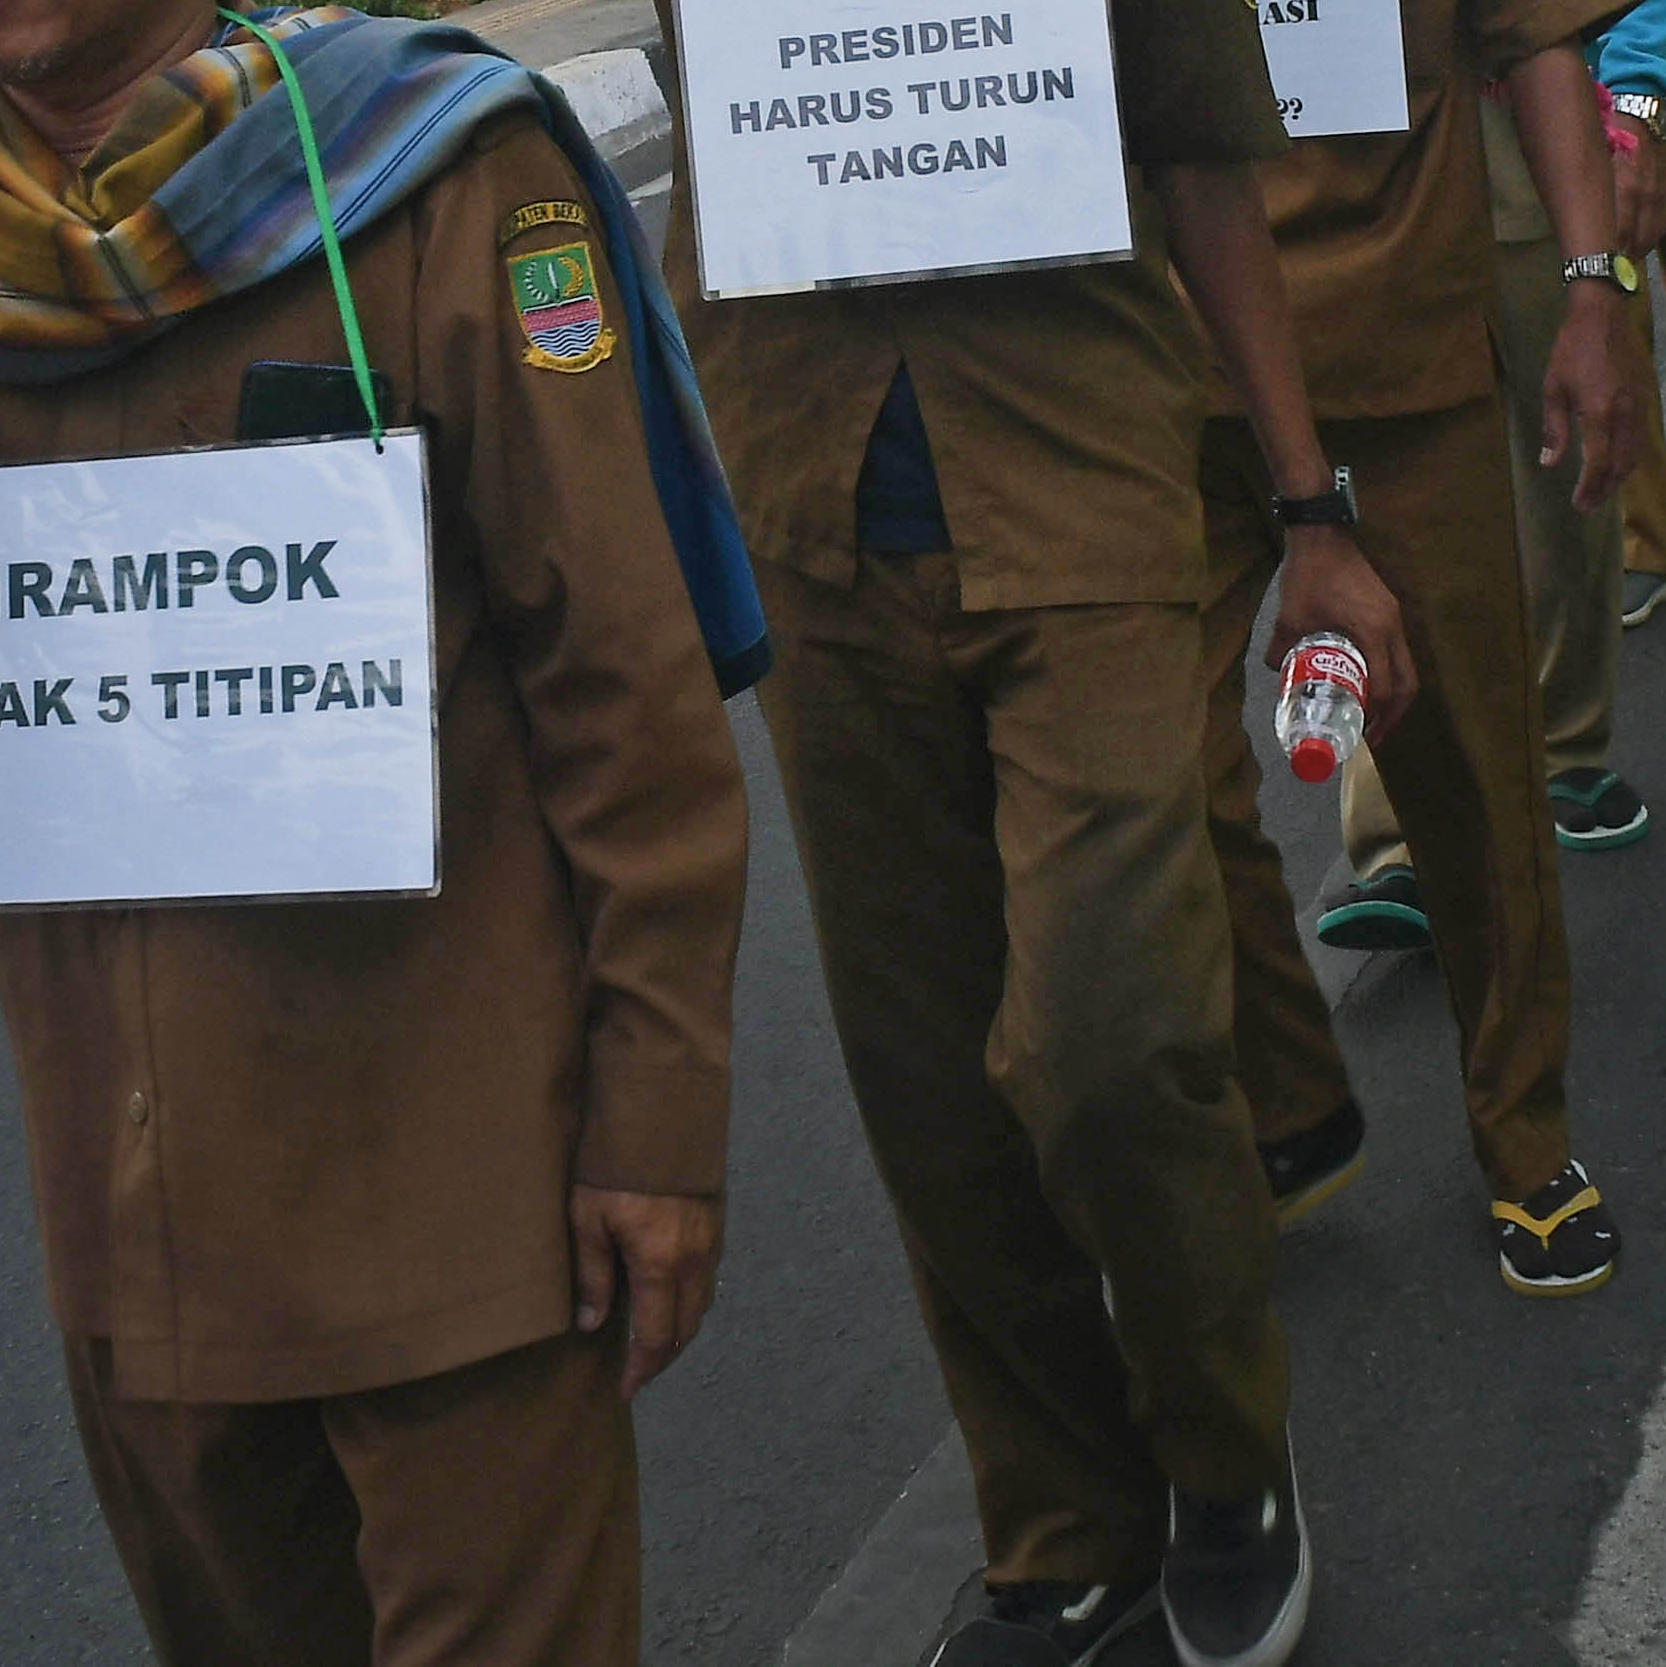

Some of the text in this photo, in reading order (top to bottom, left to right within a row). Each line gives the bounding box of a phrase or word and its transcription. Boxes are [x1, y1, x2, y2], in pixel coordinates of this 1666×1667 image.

[778, 13, 1014, 70] PRESIDEN
[729, 66, 1075, 135] HARUS TURUN
[806, 135, 1008, 186] TANGAN
[97, 674, 131, 724] 5
[150, 659, 403, 720] TITIPAN
